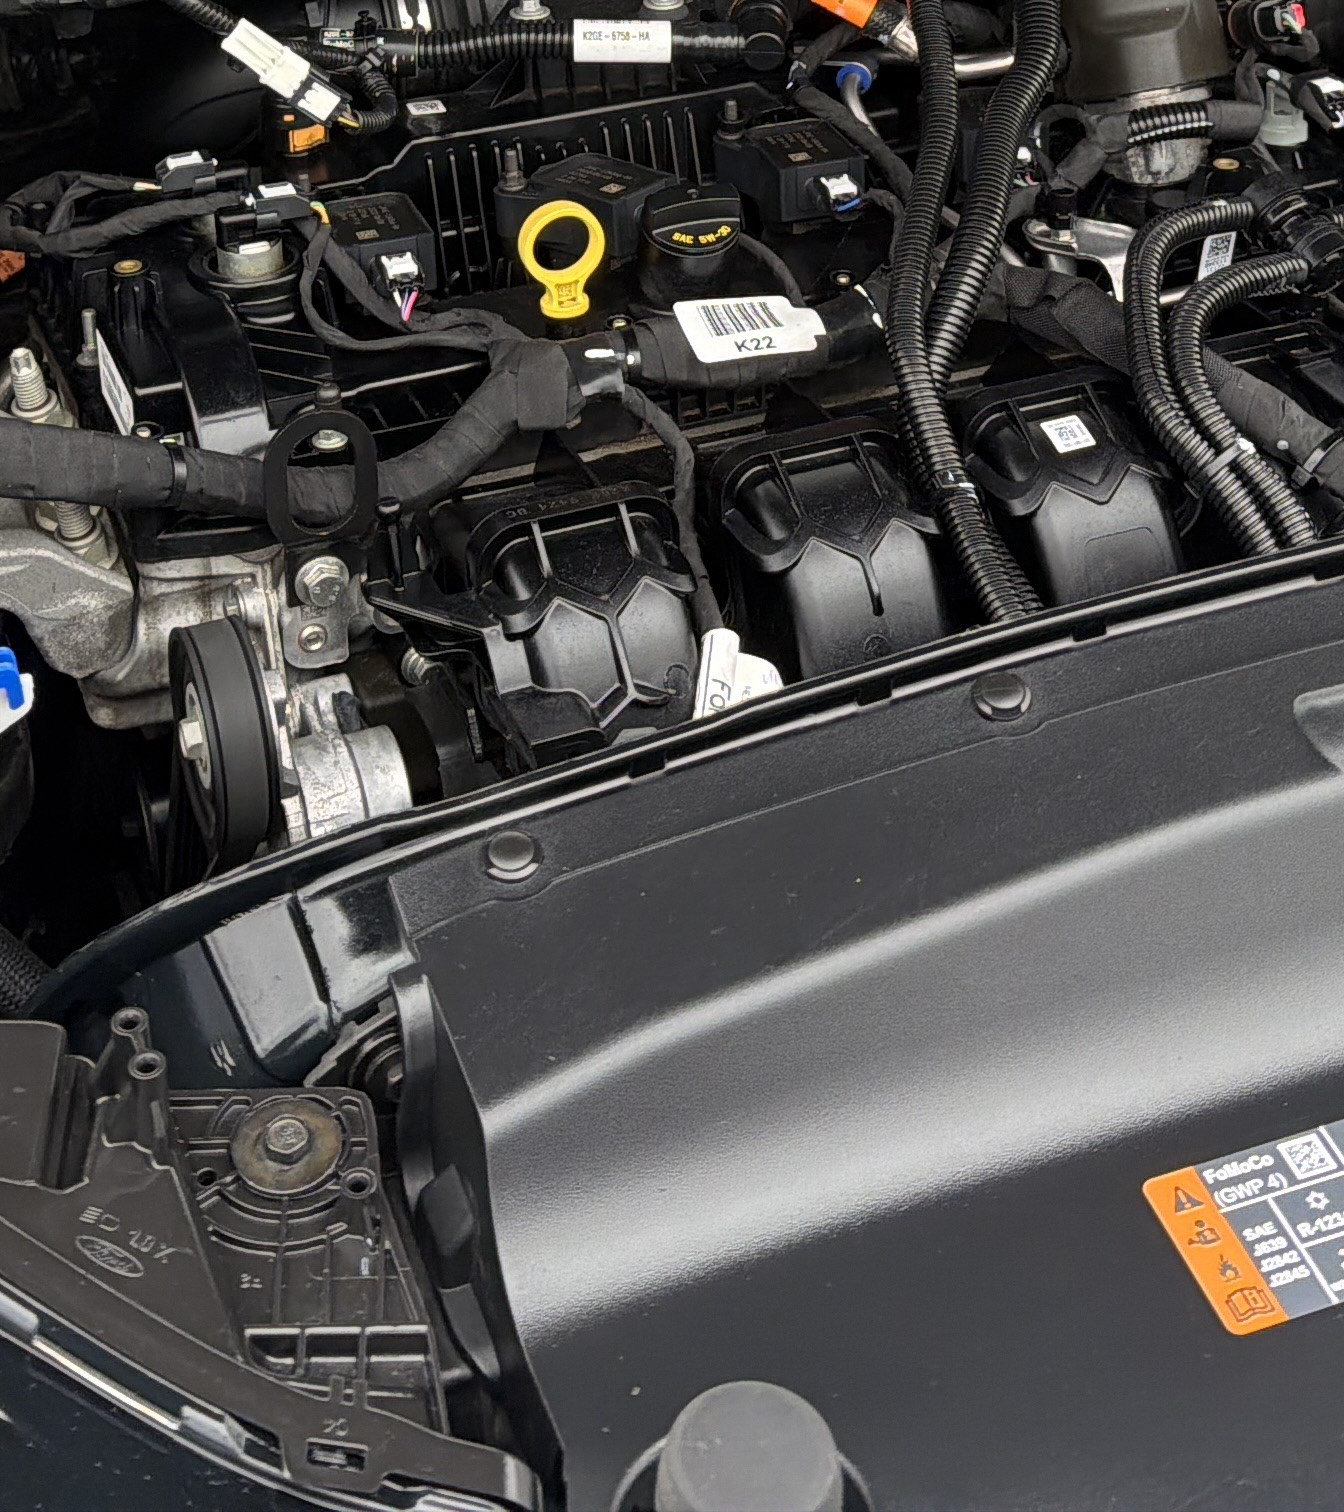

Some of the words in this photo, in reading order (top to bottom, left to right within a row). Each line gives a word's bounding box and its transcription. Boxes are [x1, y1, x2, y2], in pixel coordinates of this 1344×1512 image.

[671, 231, 695, 245] SAE
[698, 225, 732, 245] 5W-30
[734, 335, 778, 353] K22
[708, 678, 732, 712] FO
[1202, 1153, 1275, 1185] FoMoCo
[1213, 1177, 1264, 1207] (GWP
[1266, 1172, 1288, 1189] 4)
[1242, 1221, 1278, 1242] SAE
